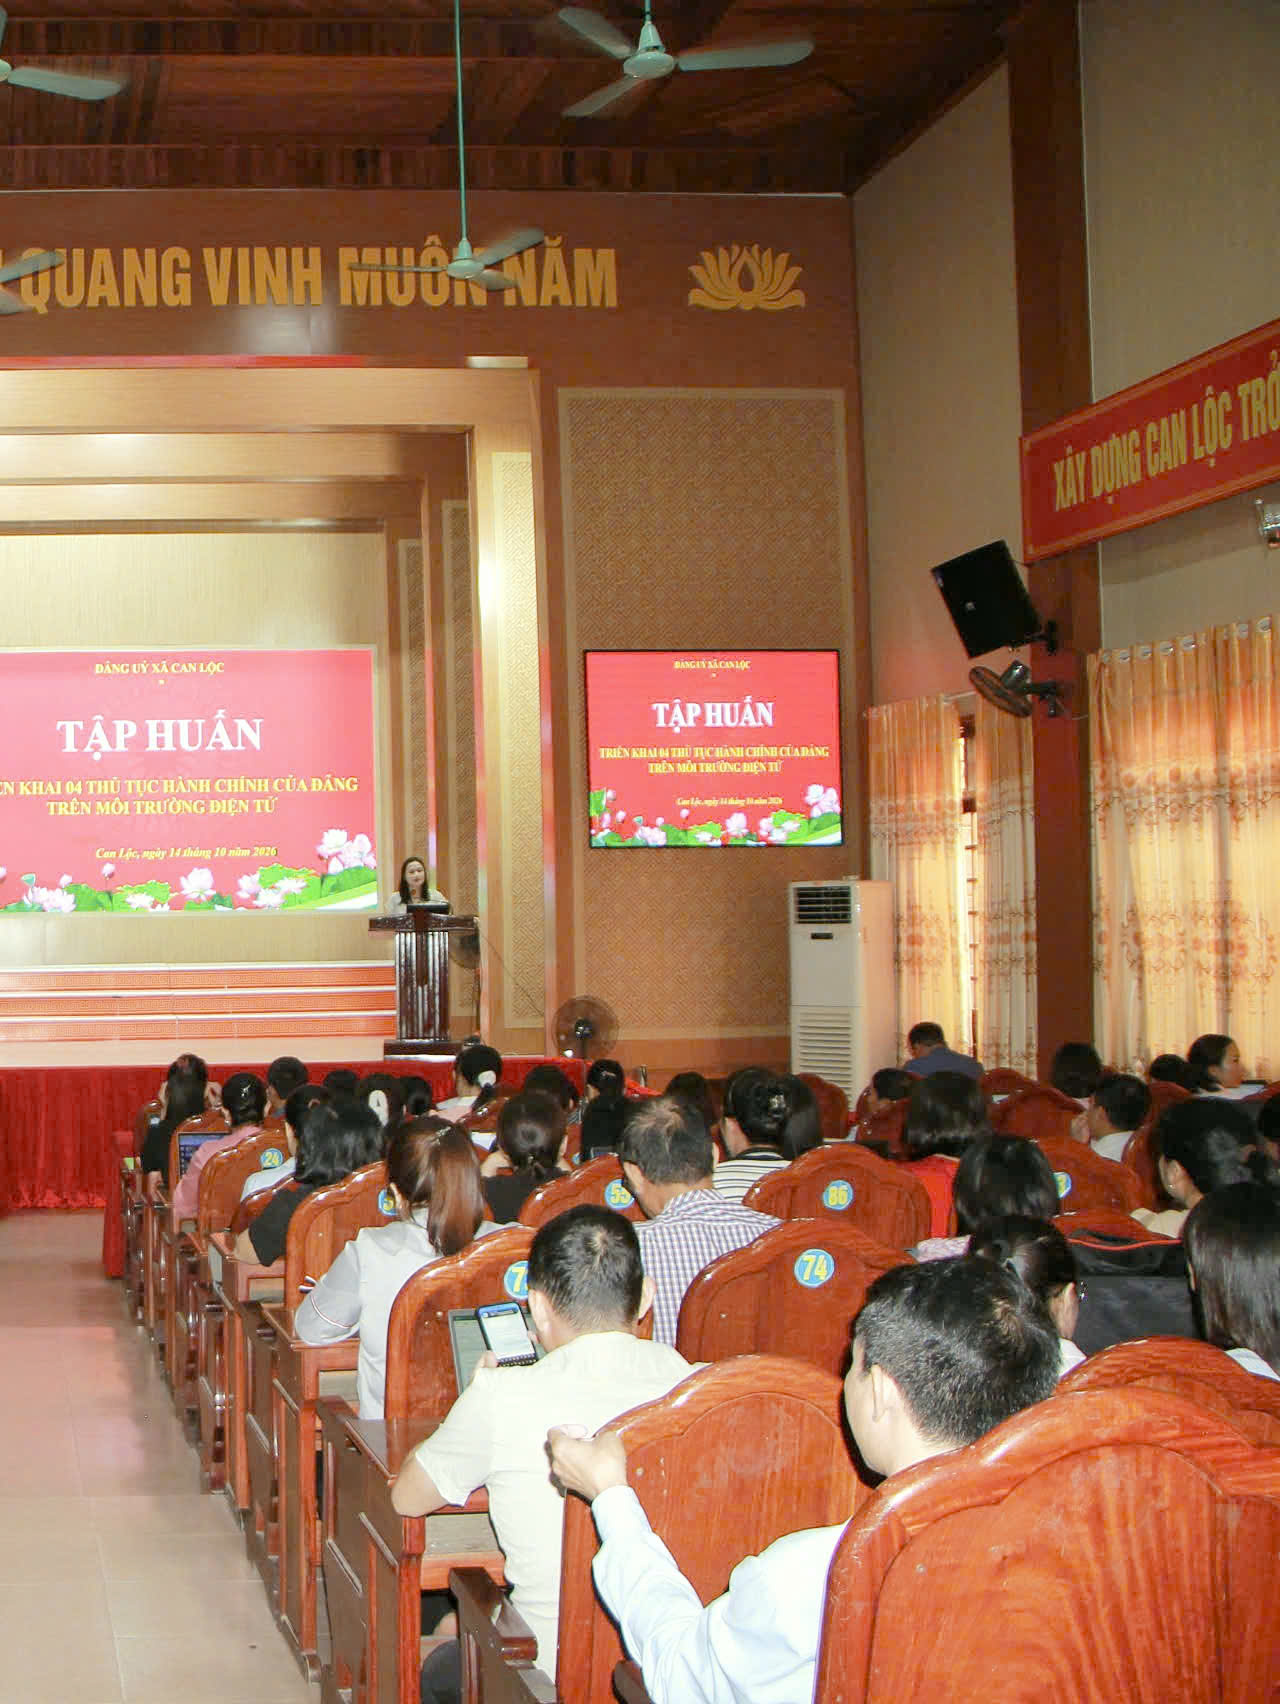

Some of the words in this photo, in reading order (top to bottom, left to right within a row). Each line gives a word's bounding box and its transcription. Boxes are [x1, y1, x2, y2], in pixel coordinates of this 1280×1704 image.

[21, 247, 192, 314] QUANG
[203, 247, 323, 305] VINH
[338, 234, 488, 306] MUÔN
[504, 235, 618, 307] NĂM
[1054, 446, 1086, 512] XÂY
[1090, 430, 1142, 504] DỰNG
[1145, 409, 1188, 477] CAN
[1192, 386, 1232, 467] LỘC
[152, 659, 169, 673] XÃ
[171, 662, 197, 673] CAN
[200, 660, 225, 675] LỘC
[652, 699, 701, 733] TẬP
[704, 695, 774, 727] HUẤN
[56, 715, 137, 760] TẬP
[145, 709, 264, 751] HUẤN
[19, 780, 62, 795] KHAI
[66, 780, 82, 794] 04
[86, 777, 121, 794] THỦ
[125, 779, 159, 797] TỤC
[163, 776, 211, 793] HÀNH
[215, 776, 269, 792] CHÍNH
[273, 774, 308, 792] CỦA
[47, 798, 91, 815] TRÊN
[96, 798, 130, 815] MÔI
[133, 798, 205, 815] TRƯỜNG
[209, 798, 249, 816] ĐIỆN
[96, 848, 116, 858] Can
[169, 848, 181, 857] 14
[214, 847, 227, 857] 10
[265, 1152, 280, 1166] 24
[511, 1265, 528, 1291] 7
[803, 1256, 827, 1280] 74
